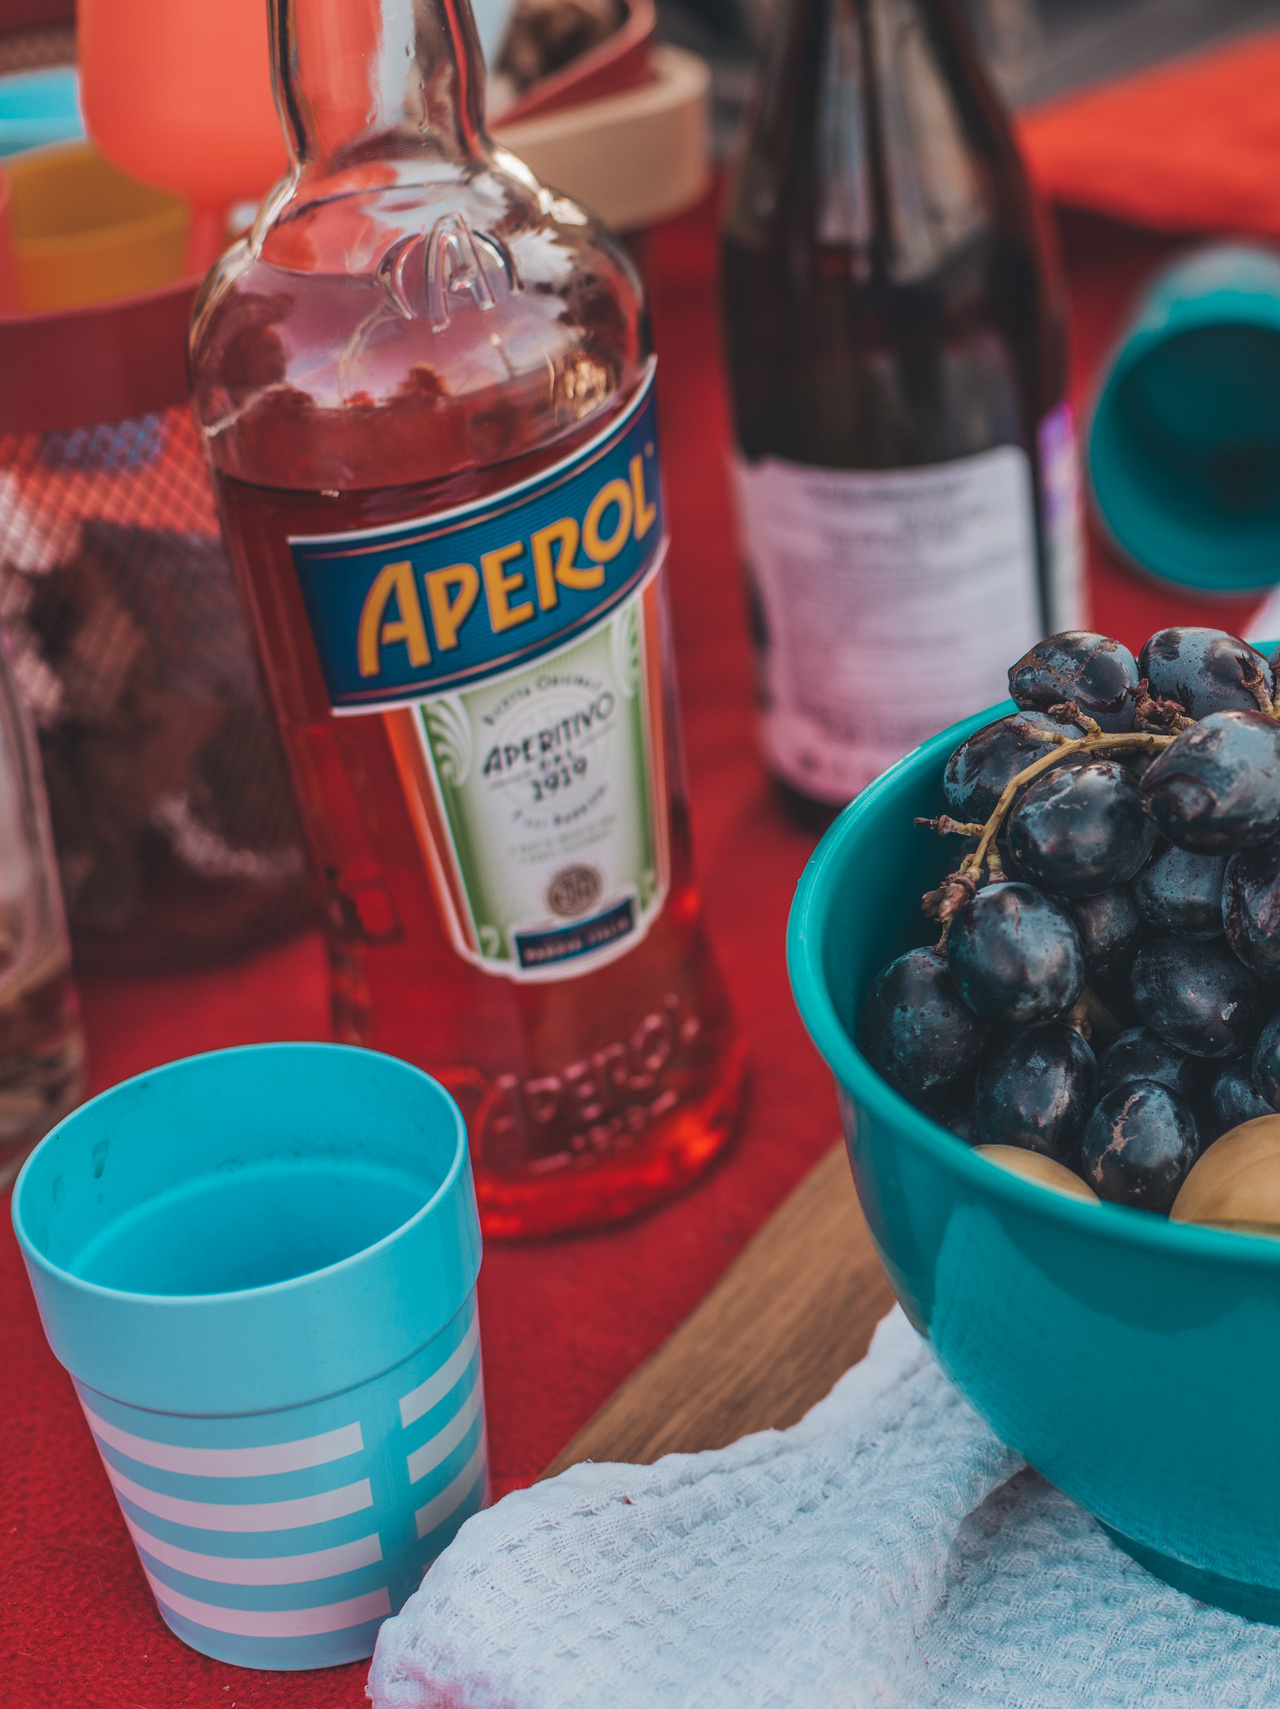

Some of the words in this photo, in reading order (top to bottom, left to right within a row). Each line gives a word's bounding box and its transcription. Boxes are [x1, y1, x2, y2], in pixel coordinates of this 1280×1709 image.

[357, 453, 657, 679] APEROL
[483, 691, 616, 776] APERITIVO
[531, 755, 588, 803] 1919
